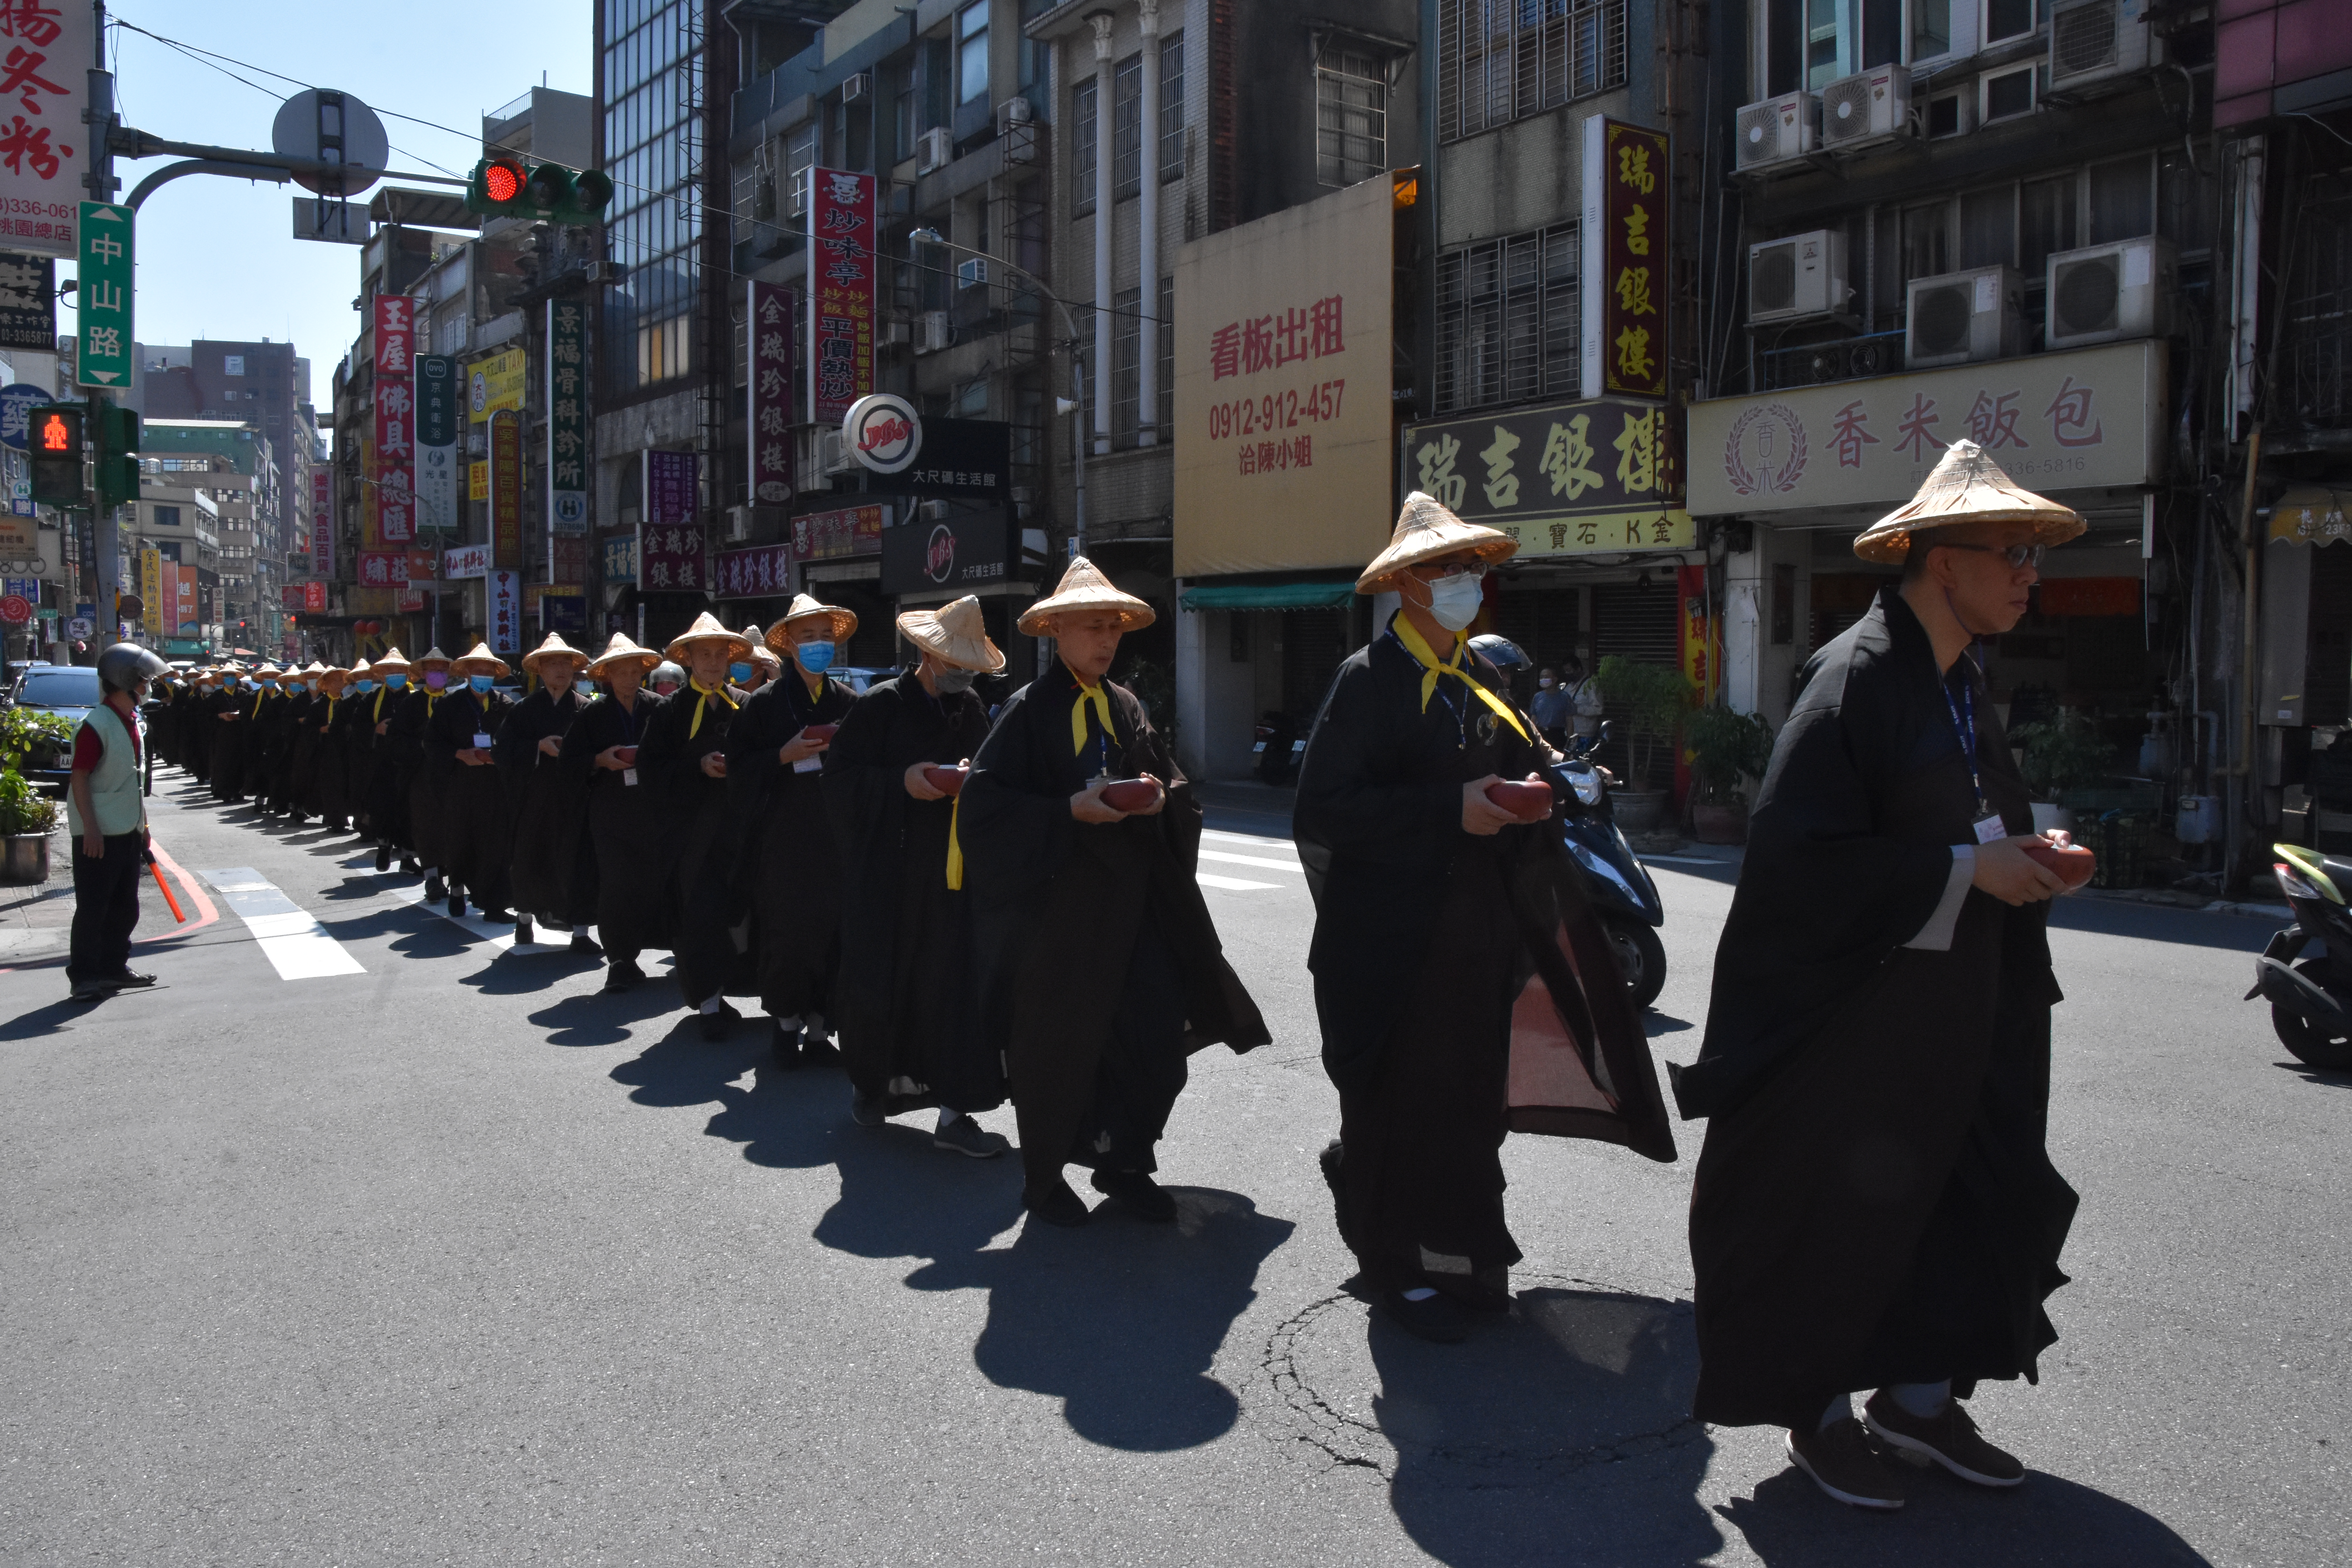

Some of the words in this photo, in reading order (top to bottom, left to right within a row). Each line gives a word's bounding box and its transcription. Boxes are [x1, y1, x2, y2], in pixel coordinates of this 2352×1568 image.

[822, 208, 867, 287] 炒味亭
[1615, 144, 1657, 381] 瑞吉銀樓
[89, 233, 122, 358] 中山路
[2, 329, 53, 345] 03-3365877
[819, 317, 854, 400] 平價熱炒
[1210, 294, 1345, 381] 看板出租
[555, 306, 582, 487] 景福骨科診所
[759, 294, 787, 472] 金瑞珍銀樓
[1210, 379, 1345, 440] 0912-912-457
[1239, 435, 1312, 476] 洽陳小姐
[1826, 376, 2103, 469] 香米飯包
[913, 469, 996, 487] 大尺碼生活館
[1416, 408, 1674, 512] 瑞吉銀樓
[1998, 457, 2085, 475] 336-5816
[644, 527, 703, 555] 金瑞珍
[650, 561, 697, 588] 銀樓
[716, 550, 788, 595] 金瑞珍銀樓
[962, 562, 1004, 579] 大尺碼生活館
